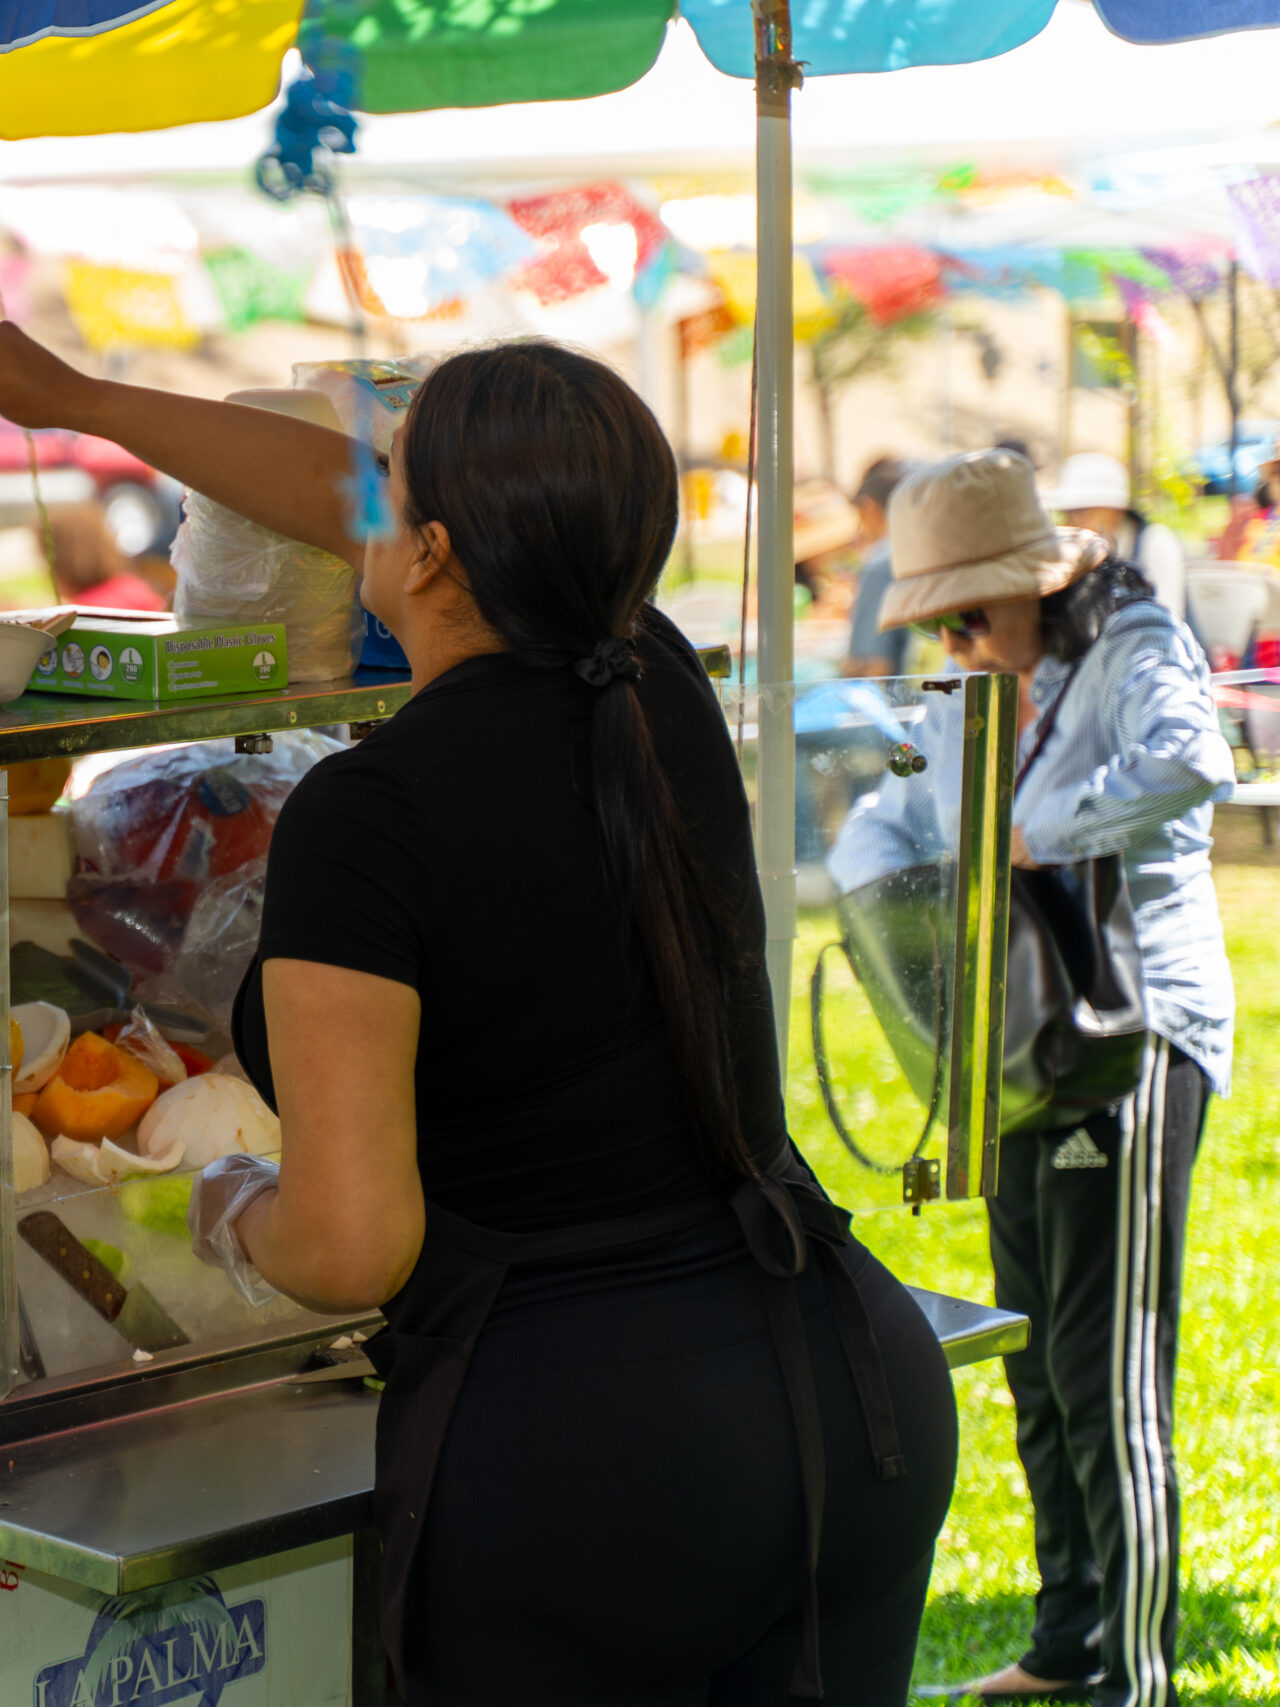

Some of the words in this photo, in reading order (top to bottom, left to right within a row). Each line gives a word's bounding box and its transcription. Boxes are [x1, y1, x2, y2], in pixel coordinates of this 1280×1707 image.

[166, 635, 213, 654] Disposable
[215, 635, 243, 648] Plastic
[245, 632, 277, 645] Gloves
[108, 1613, 264, 1707] PALMA
